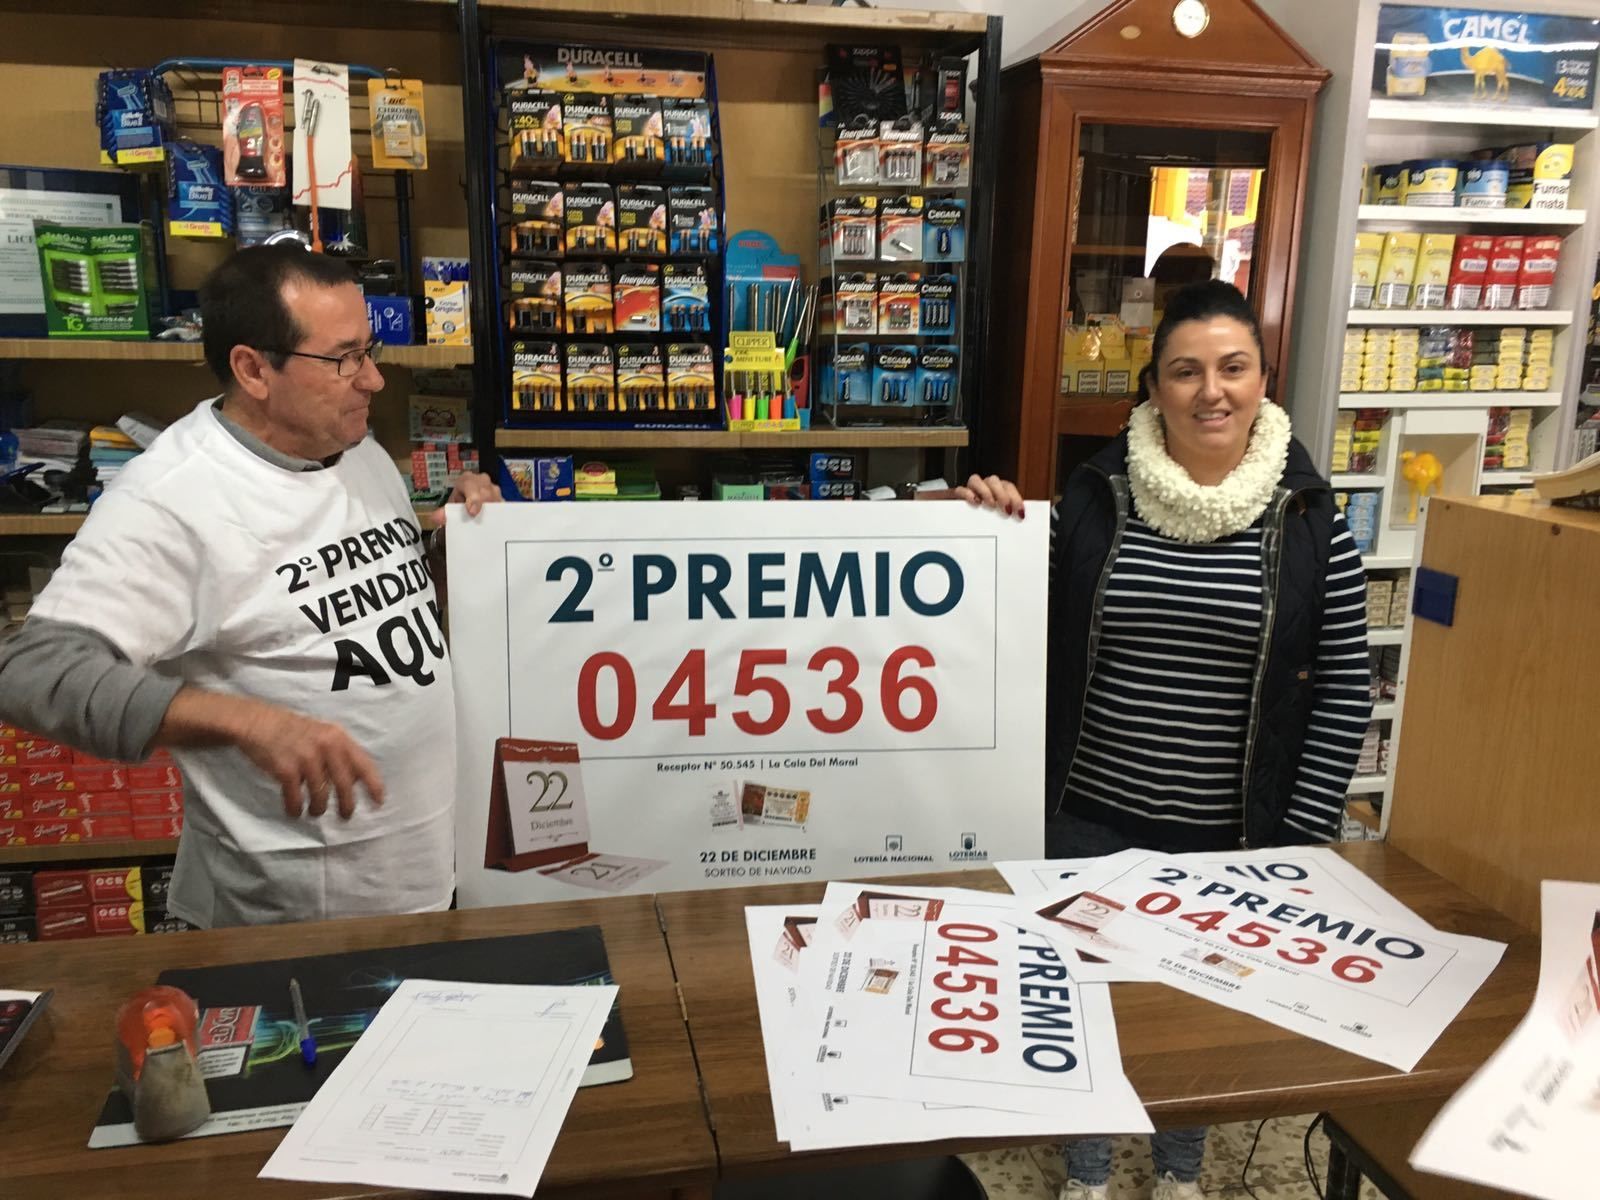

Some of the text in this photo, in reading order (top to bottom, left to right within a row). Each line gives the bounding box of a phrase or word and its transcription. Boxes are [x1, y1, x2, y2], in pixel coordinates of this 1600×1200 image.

[1442, 15, 1531, 45] CAMEL
[557, 47, 643, 67] DURACELL
[564, 106, 609, 114] DURACELL
[615, 107, 651, 115] DURACELL
[663, 109, 698, 117] DURACELL
[839, 129, 876, 140] Energizer
[882, 131, 920, 142] Energizer
[929, 134, 966, 144] Energizer
[513, 193, 549, 201] DURACELL
[566, 196, 603, 205] DURACELL
[620, 198, 656, 207] DURACELL
[671, 199, 706, 207] DURACELL
[836, 207, 861, 215] Energizer
[882, 207, 907, 215] Energizer
[511, 272, 547, 280] DURACELL
[566, 274, 609, 282] DURACELL
[619, 274, 657, 286] Energizer
[664, 276, 706, 284] DURACELL
[840, 282, 874, 292] Energizer
[882, 282, 917, 292] Energizer
[514, 353, 558, 363] DURACELL
[568, 355, 611, 363] DURACELL
[620, 356, 661, 364] DURACELL
[669, 355, 712, 363] DURACELL
[815, 458, 852, 472] OCB
[818, 484, 855, 497] OCB
[632, 550, 964, 622] PREMIO
[577, 645, 938, 740] 04536
[657, 762, 701, 773] Receptor
[720, 760, 755, 770] 50.545
[769, 759, 781, 769] La
[809, 758, 826, 768] Del
[828, 757, 859, 767] Moral
[526, 770, 574, 813] 22
[530, 817, 573, 831] Diciembre
[700, 848, 817, 863] 22 DE DICIEMBRE
[891, 855, 934, 863] NACIONAL
[705, 866, 812, 878] SORTEO DE NAVIDAD
[95, 876, 124, 886] OCB
[98, 908, 127, 917] OCB
[1197, 881, 1425, 959] PREMIO
[1135, 891, 1384, 984] 04536
[1189, 968, 1243, 991] DICIEMBRE
[928, 922, 999, 1055] 04536
[1017, 944, 1078, 1073] PREMIO
